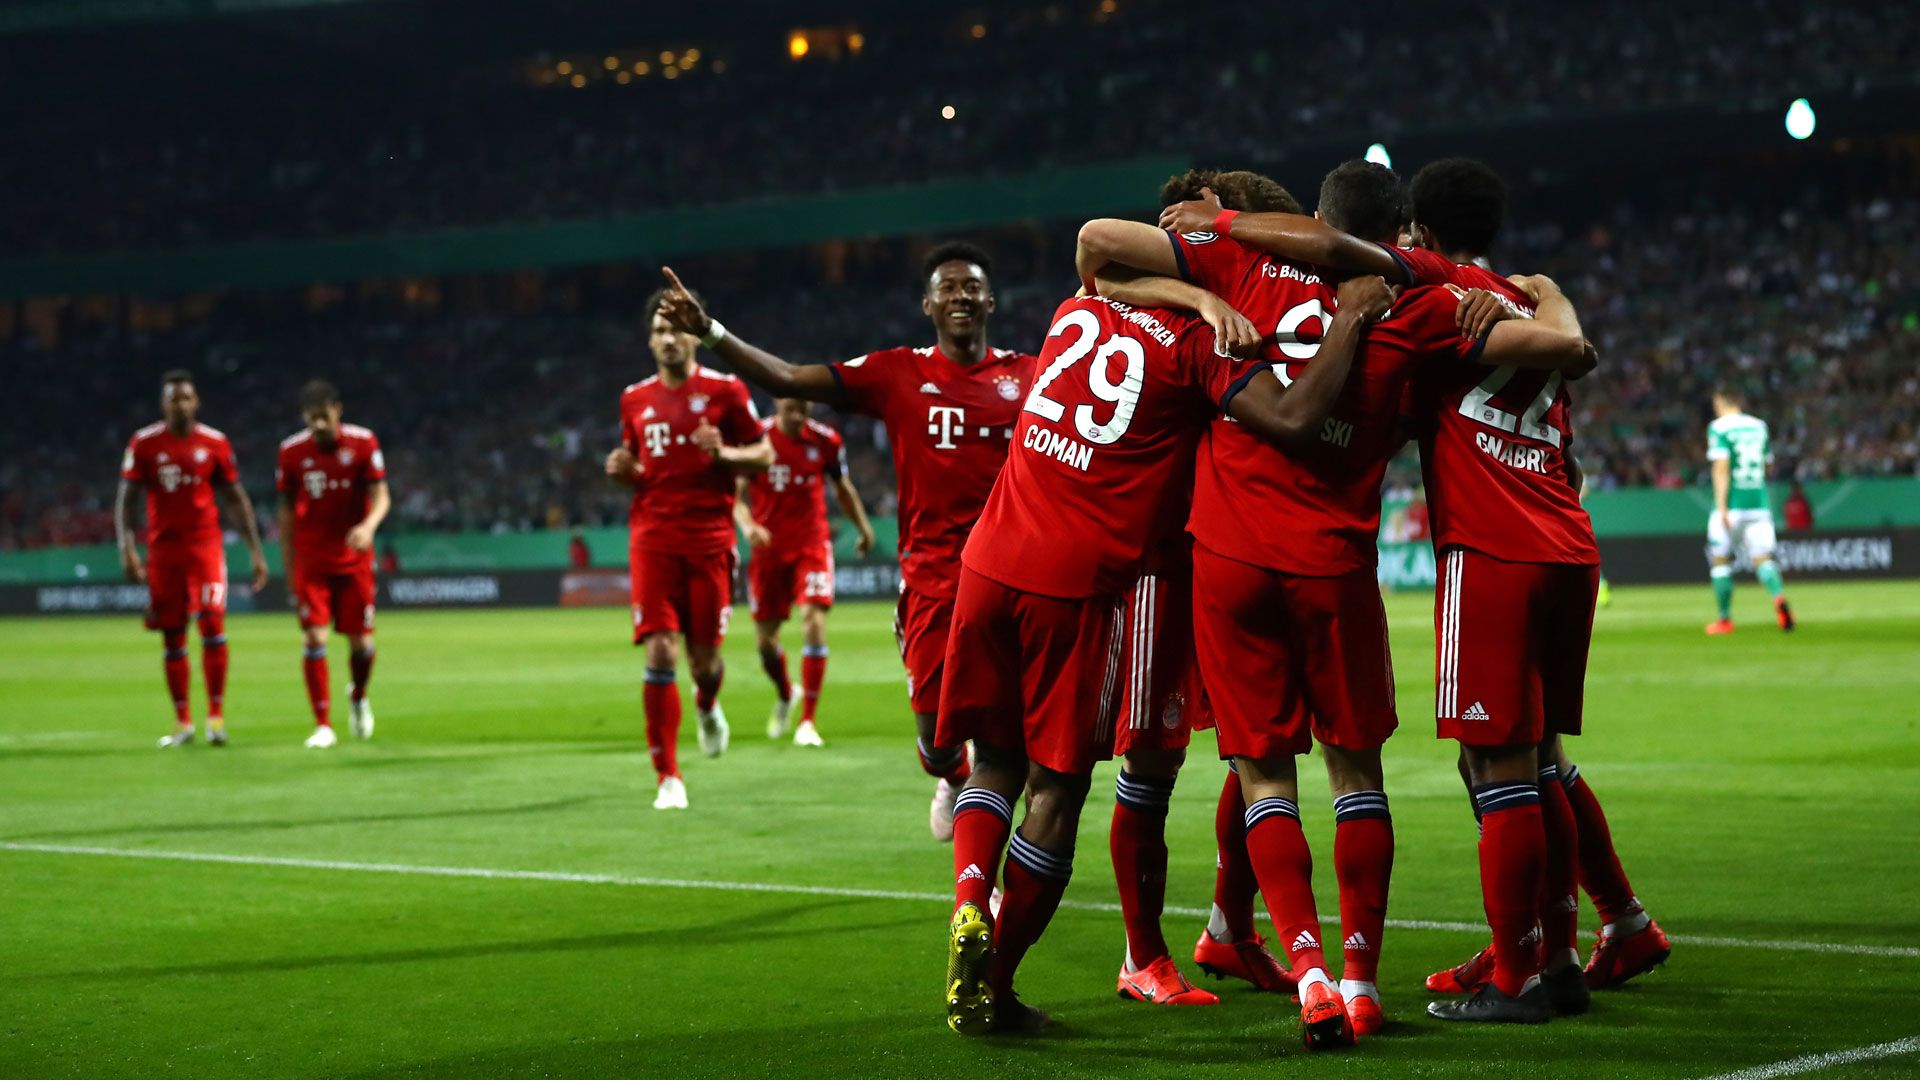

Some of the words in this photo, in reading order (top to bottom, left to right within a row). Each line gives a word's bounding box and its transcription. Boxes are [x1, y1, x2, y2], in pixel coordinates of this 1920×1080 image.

[1261, 262, 1278, 279] FC
[1279, 264, 1324, 286] BAYER
[1022, 308, 1146, 445] 29
[1023, 423, 1095, 473] COMAN
[200, 581, 225, 607] 17
